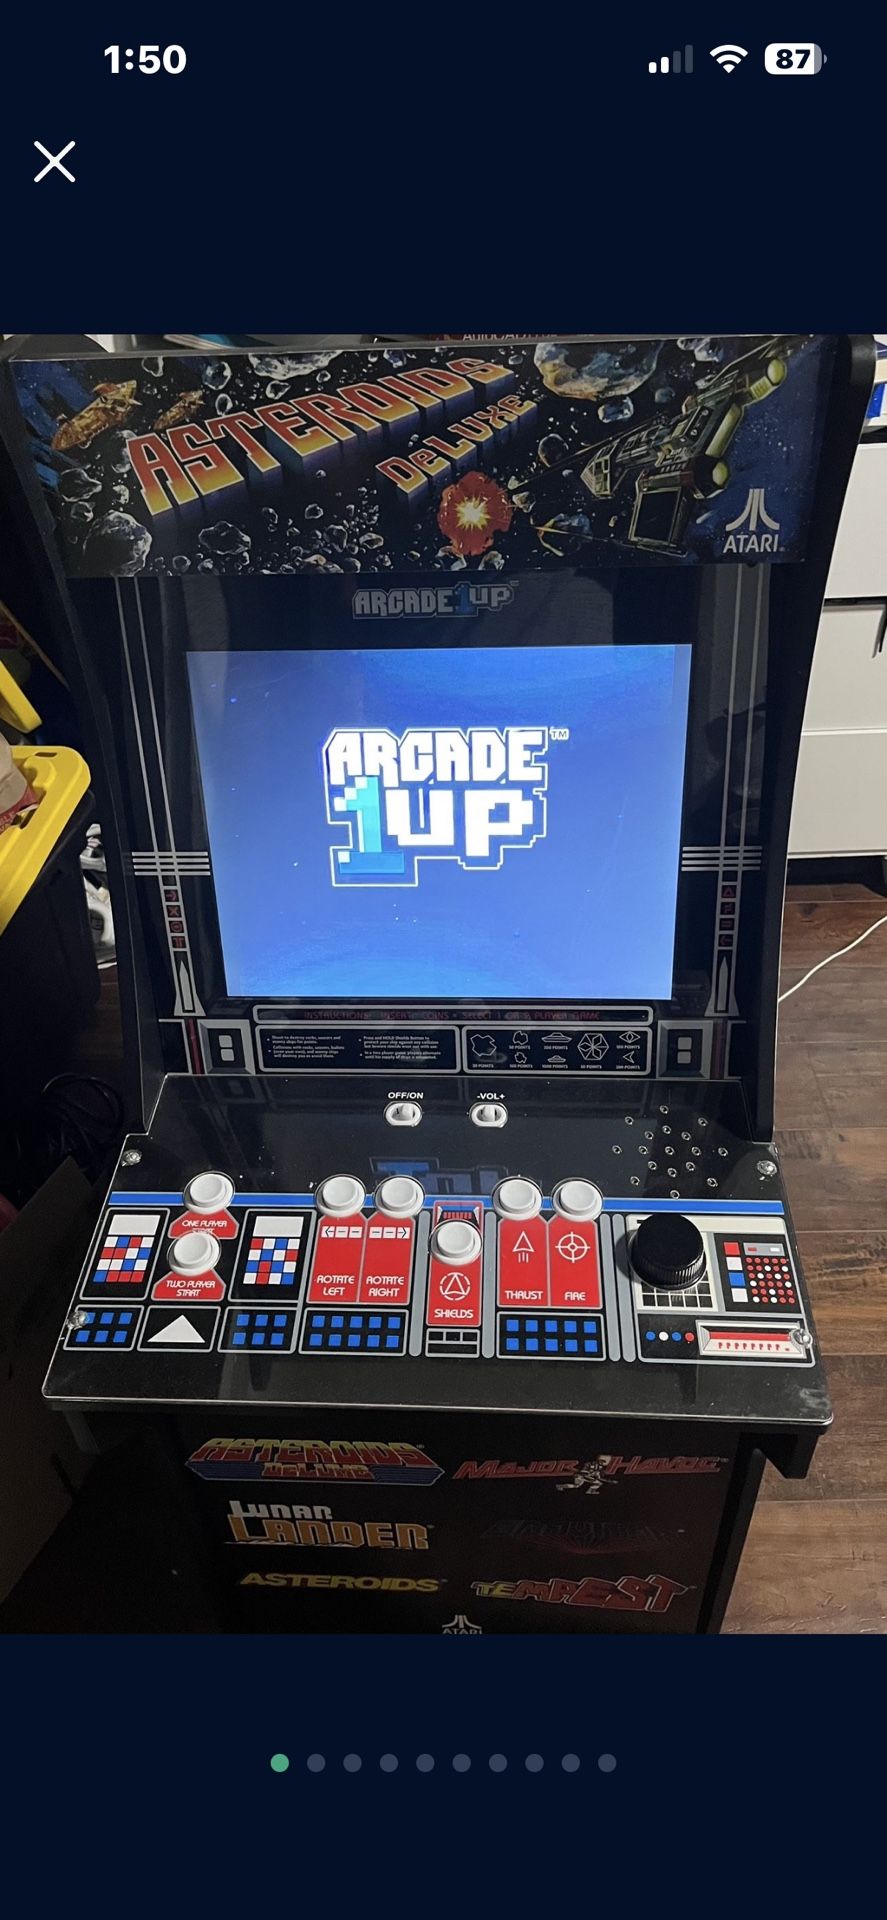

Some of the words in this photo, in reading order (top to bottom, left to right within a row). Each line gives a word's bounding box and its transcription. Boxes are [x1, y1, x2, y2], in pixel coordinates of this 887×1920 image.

[127, 358, 513, 516] ASTEROIDS
[723, 533, 779, 554] ATARI
[325, 730, 544, 788] ARCADE
[333, 776, 534, 875] 1UP
[387, 1091, 424, 1099] OFF/ON
[477, 1092, 505, 1100] -VOL+
[181, 1219, 199, 1227] ONE
[166, 1280, 186, 1288] TWO
[187, 1280, 215, 1288] PLAYER
[316, 1275, 355, 1284] ROTATE
[366, 1276, 404, 1285] ROTATE
[323, 1287, 345, 1296] LEFT
[368, 1288, 400, 1297] RIGHT
[505, 1290, 543, 1300] THRUST
[564, 1291, 586, 1300] FIRE
[434, 1308, 474, 1318] SHIELDS
[190, 1438, 437, 1468] ASTEROIDS
[229, 1500, 333, 1520] LUNAR
[226, 1514, 430, 1550] LANDER
[240, 1573, 440, 1592] ASTEROIDS
[471, 1575, 689, 1613] TEMPEST
